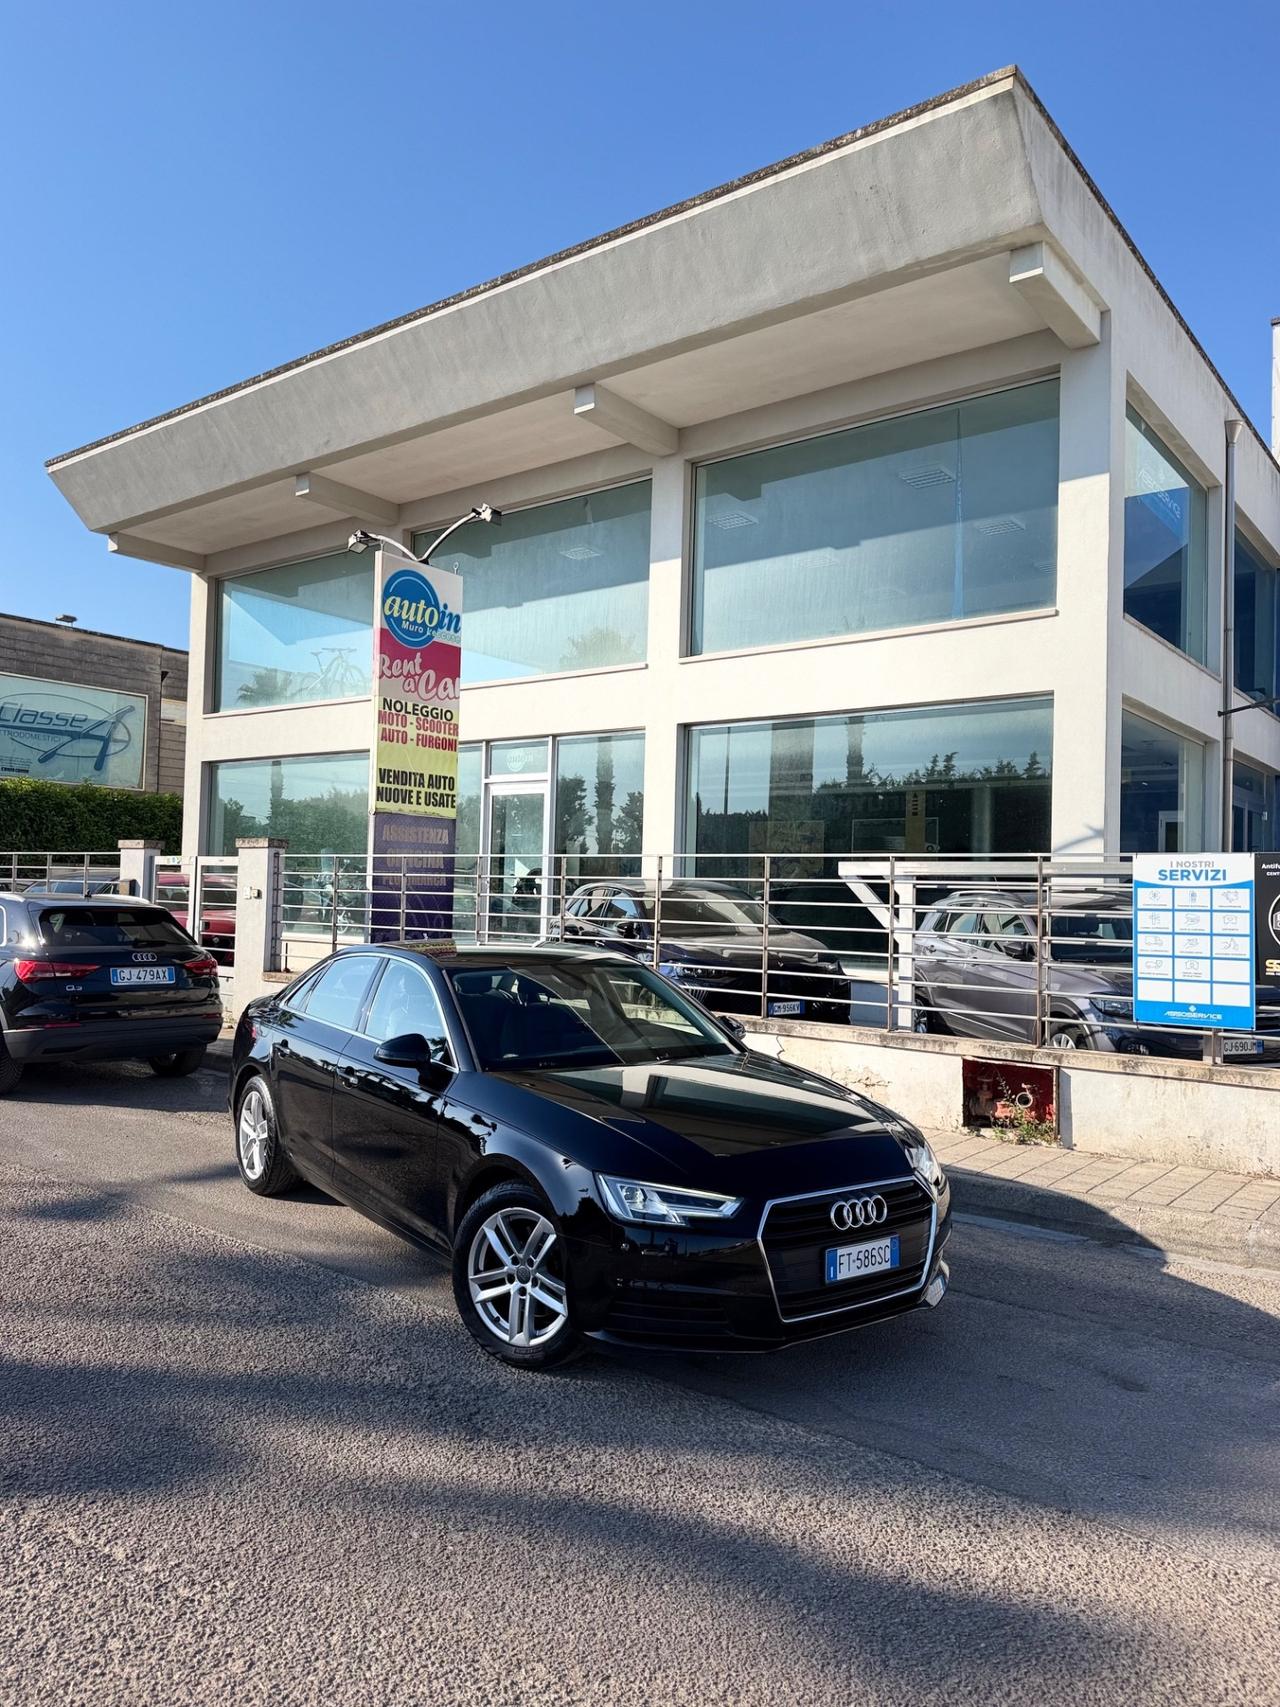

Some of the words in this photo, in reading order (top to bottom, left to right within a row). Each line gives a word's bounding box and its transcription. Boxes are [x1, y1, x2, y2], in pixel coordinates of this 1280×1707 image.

[401, 621, 424, 634] Muro
[379, 652, 422, 678] Rent
[383, 697, 454, 722] NOLEGGIO
[378, 709, 408, 729] MOTO
[415, 717, 459, 737] SCOOTER
[381, 727, 408, 745] AUTO
[416, 733, 457, 753] FURGONI
[379, 767, 425, 789] VENDITA
[427, 773, 455, 792] AUTO
[376, 786, 413, 804] NUOVE
[416, 790, 422, 806] E
[424, 791, 456, 809] USATE
[1158, 869, 1227, 882] SERVIZI
[1177, 860, 1215, 868] NOSTRI
